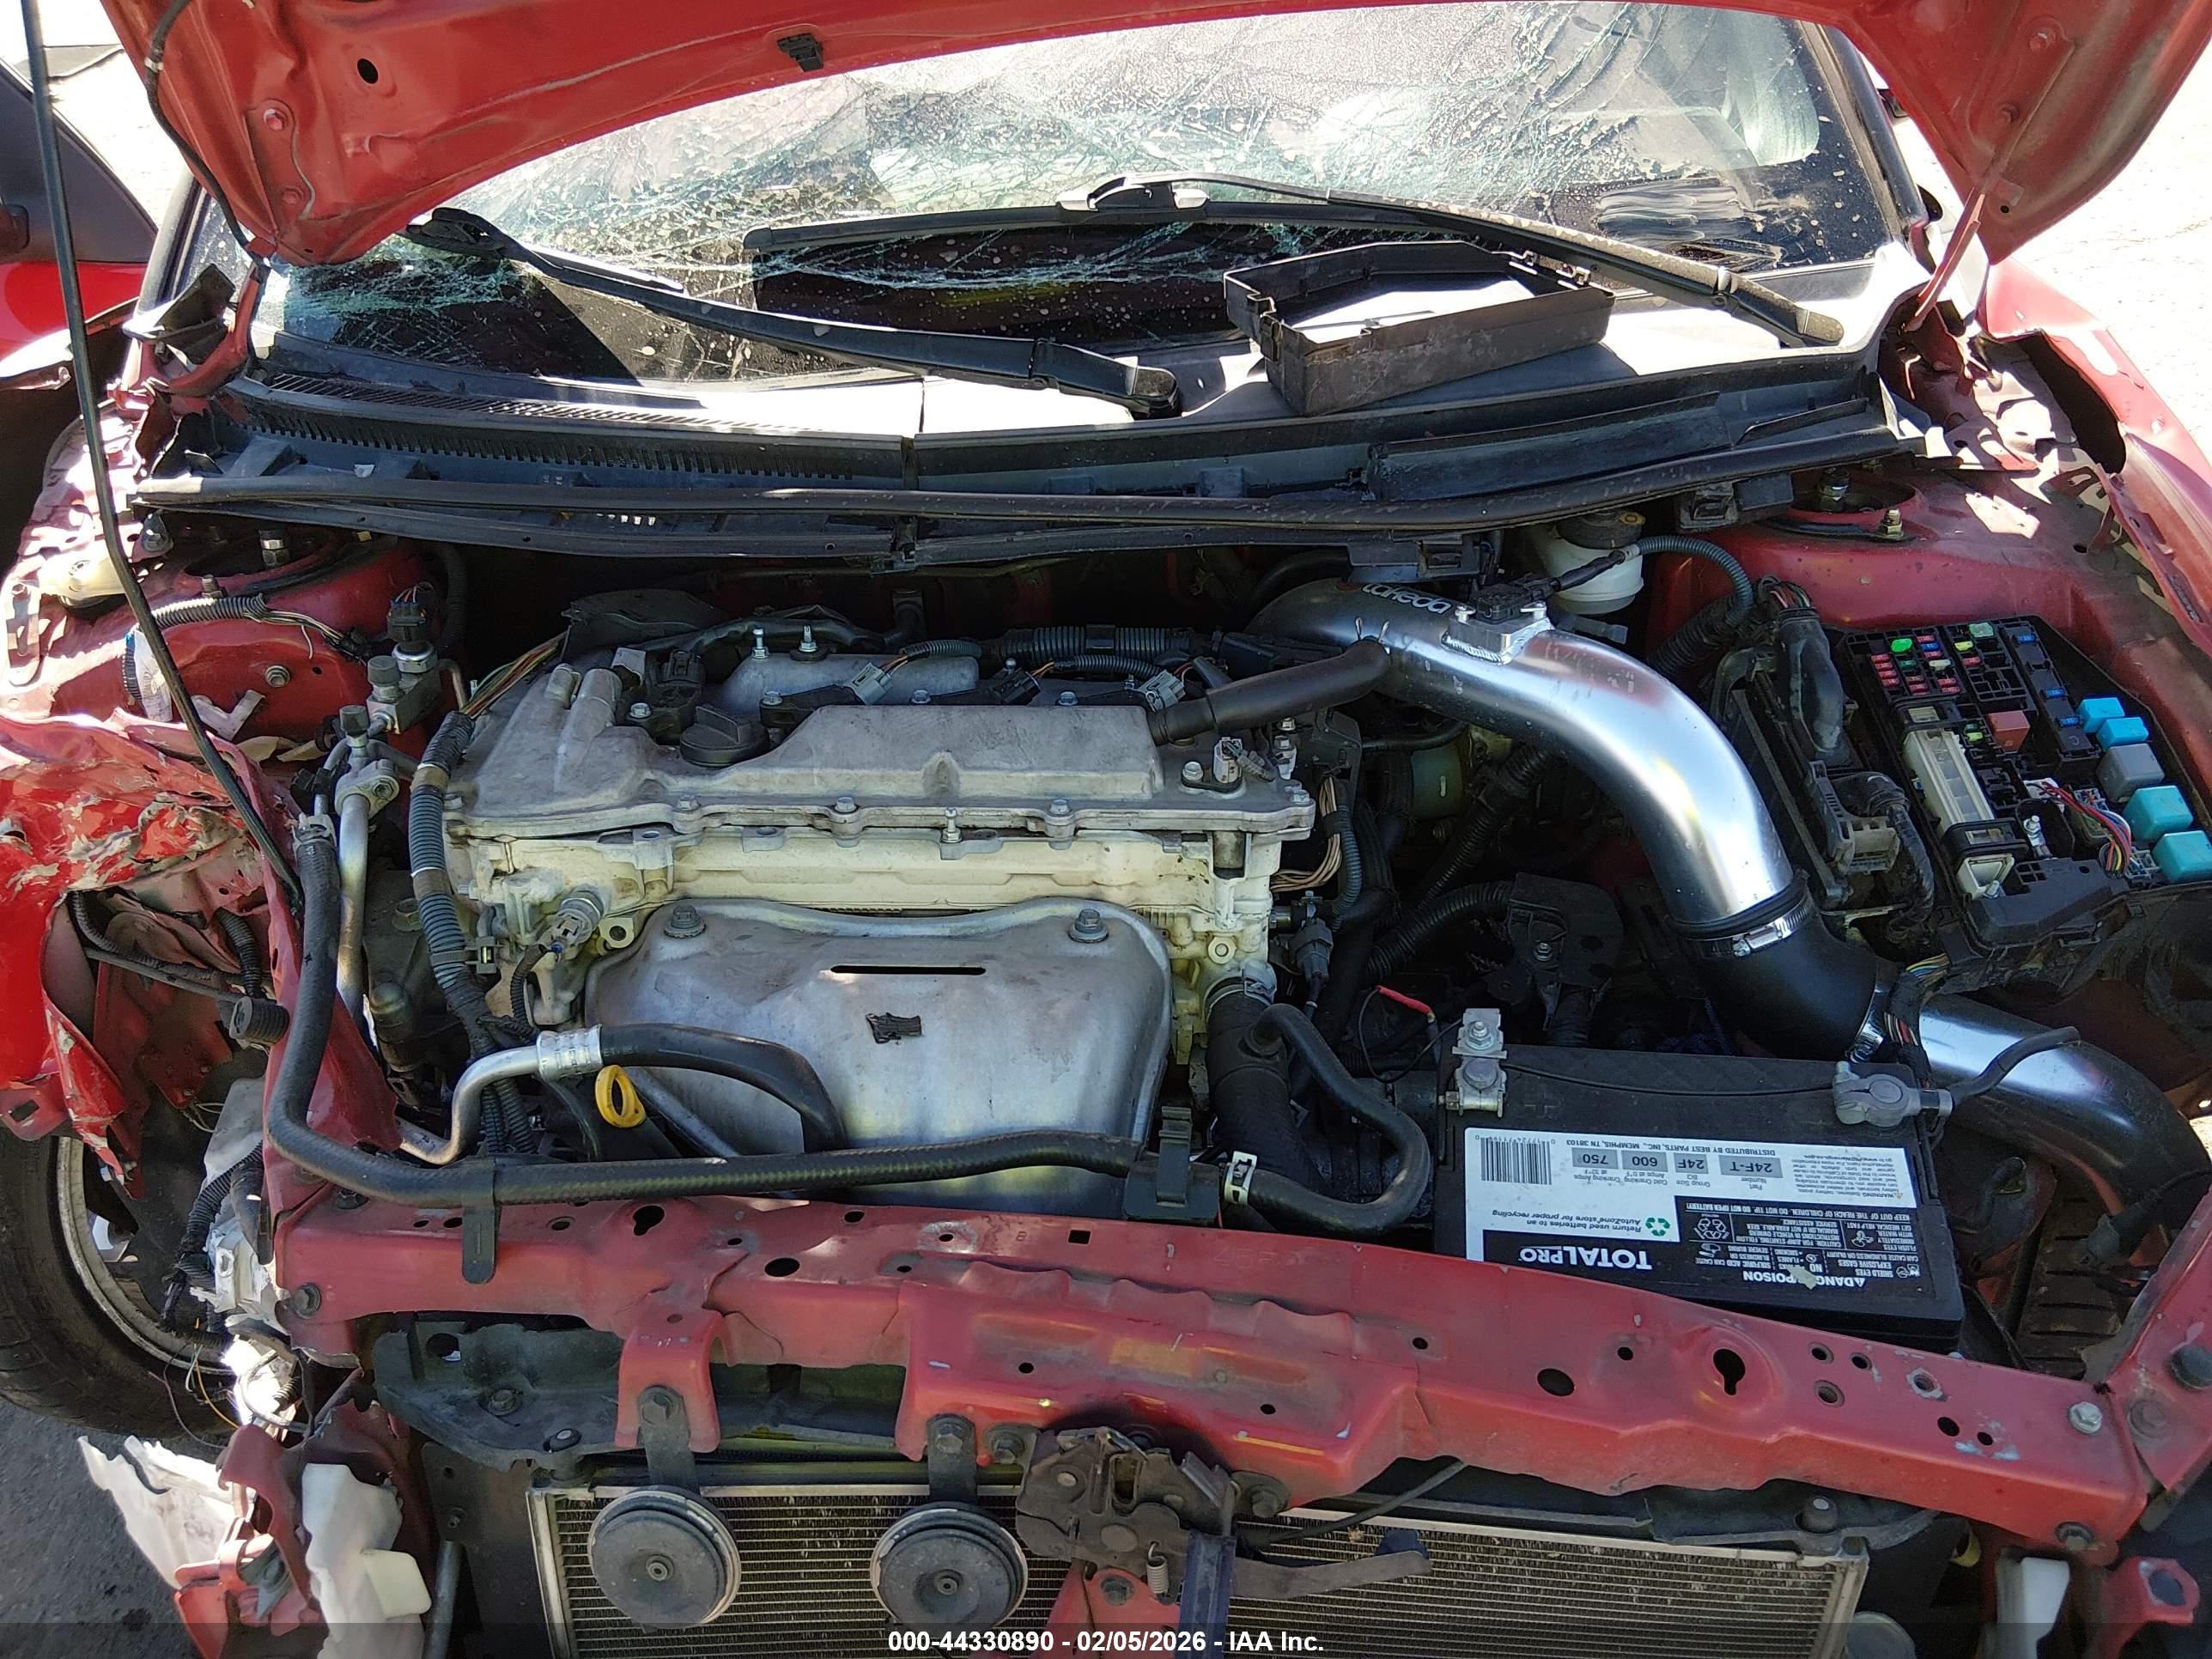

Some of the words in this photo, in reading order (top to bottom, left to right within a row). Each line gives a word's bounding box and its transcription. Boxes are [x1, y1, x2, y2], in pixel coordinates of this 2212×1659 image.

[1601, 1140, 1639, 1149] MEMPHIS,
[1725, 1147, 1776, 1156] DISTRIBUTED
[1583, 1154, 1608, 1164] 750
[1632, 1157, 1657, 1167] 600
[1677, 1158, 1705, 1170] 24F
[1729, 1161, 1772, 1173] 24F-T
[1549, 1220, 1587, 1229] batteries
[1742, 1261, 1771, 1269] SULFURIC
[1838, 1259, 1858, 1267] GASES
[1858, 1261, 1892, 1269] EXPLOSIVE
[1809, 1264, 1823, 1273] NO
[1872, 1269, 1893, 1278] SHIELD
[1743, 1271, 1855, 1287] DANG/POISON
